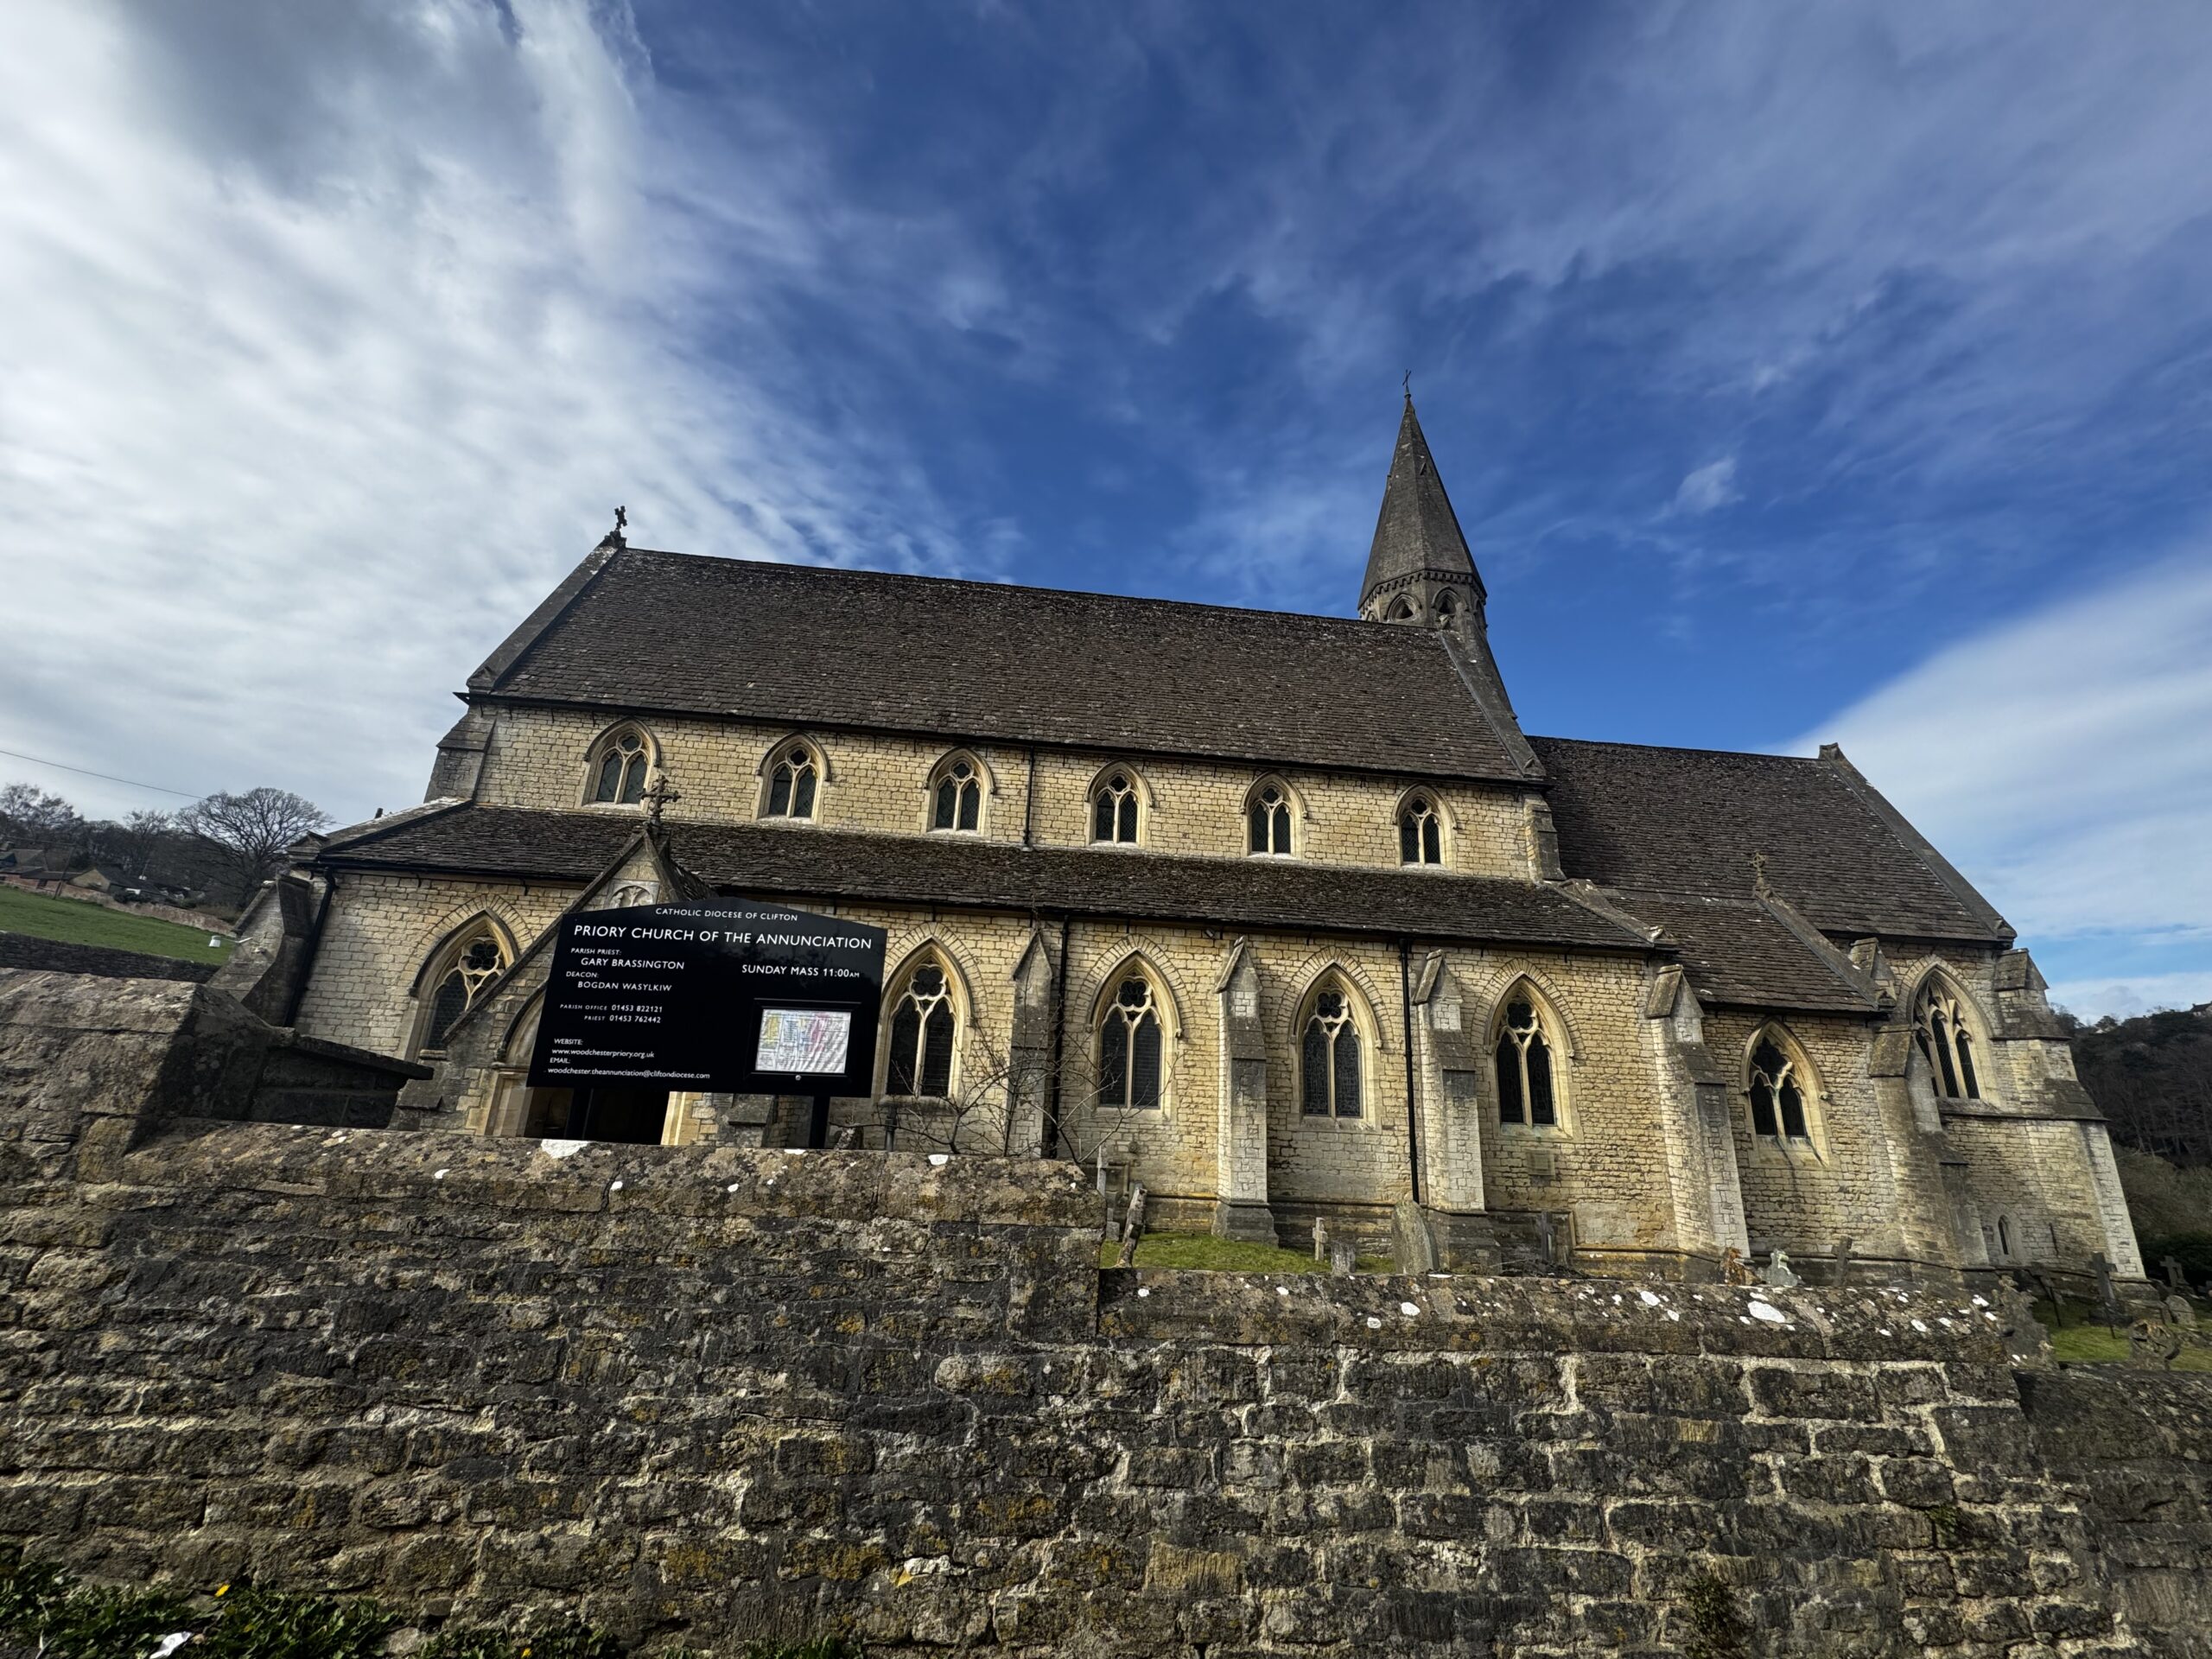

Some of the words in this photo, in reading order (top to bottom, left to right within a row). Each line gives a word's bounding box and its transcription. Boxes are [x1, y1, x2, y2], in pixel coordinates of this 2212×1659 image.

[575, 925, 626, 937] PRIORY
[632, 928, 694, 940] CHURCH
[700, 931, 719, 941] OF
[725, 932, 751, 943] THE
[756, 934, 871, 949] ANNUNCIATION
[612, 959, 684, 969] BRASSINGTON
[742, 964, 787, 974] SUNDAY
[791, 967, 818, 976] MASS
[823, 969, 859, 977] 11:00AM
[551, 1048, 655, 1058] www.woodchesterpriory.org.uk
[548, 1067, 710, 1079] woodchester.theannunciation@cliftondiocese.com
